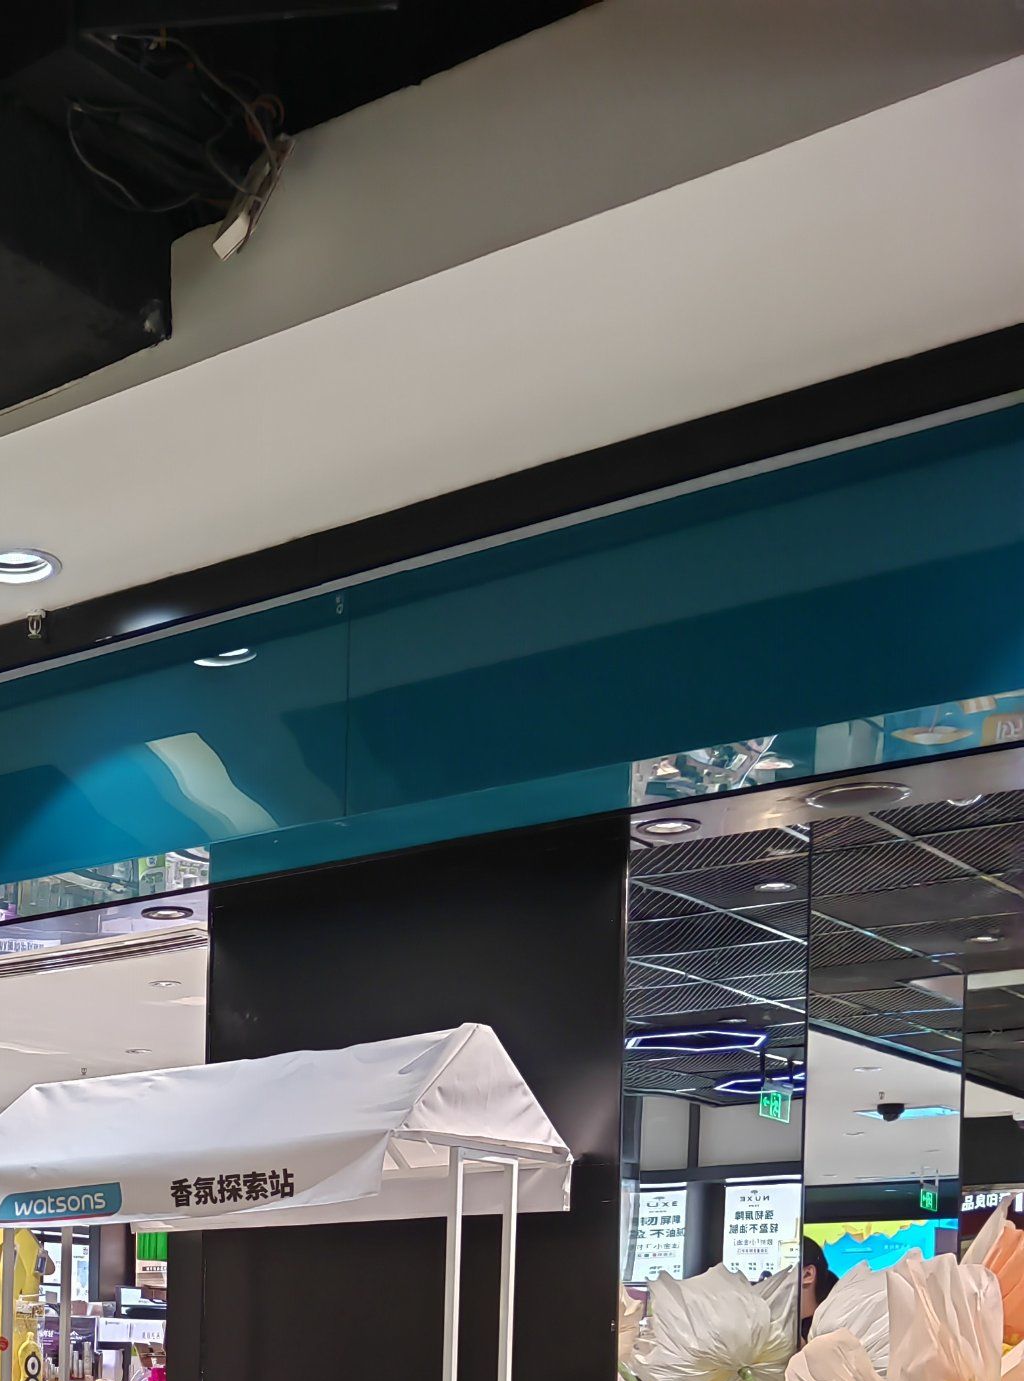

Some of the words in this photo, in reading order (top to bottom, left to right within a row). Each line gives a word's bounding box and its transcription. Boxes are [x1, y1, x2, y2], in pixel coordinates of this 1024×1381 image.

[170, 1168, 295, 1207] 香氛探索站
[14, 1192, 106, 1216] watsons
